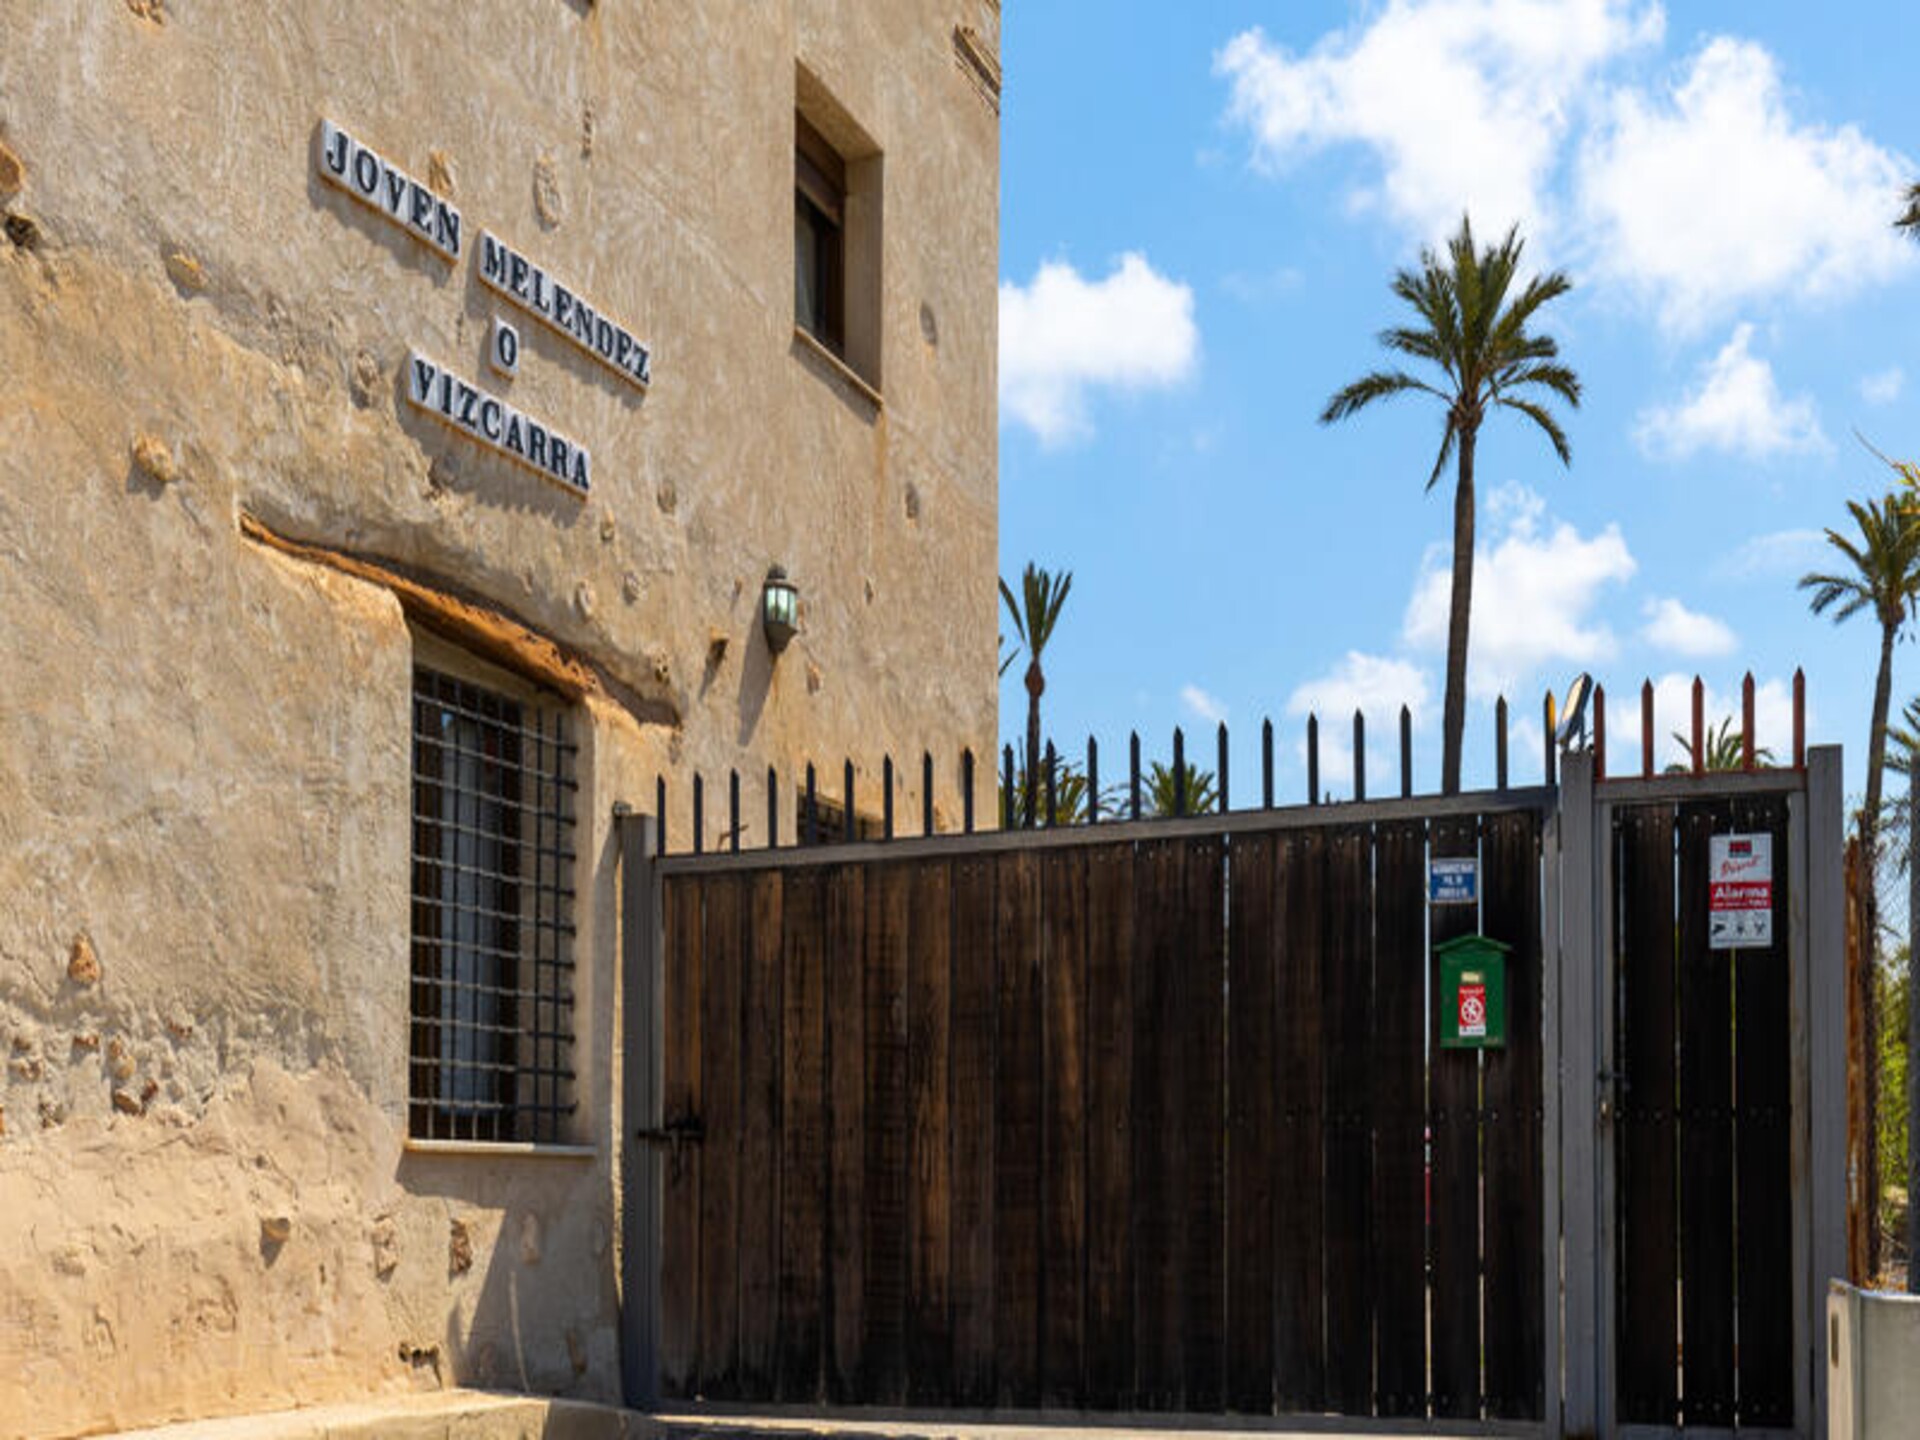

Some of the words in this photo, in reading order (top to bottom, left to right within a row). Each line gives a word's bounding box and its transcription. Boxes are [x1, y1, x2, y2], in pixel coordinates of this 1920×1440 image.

[326, 131, 460, 254] JOVEN
[484, 236, 650, 386] MELENDEZ
[497, 326, 518, 367] O
[414, 359, 591, 489] VIZCARRA
[1714, 886, 1768, 899] Alarma
